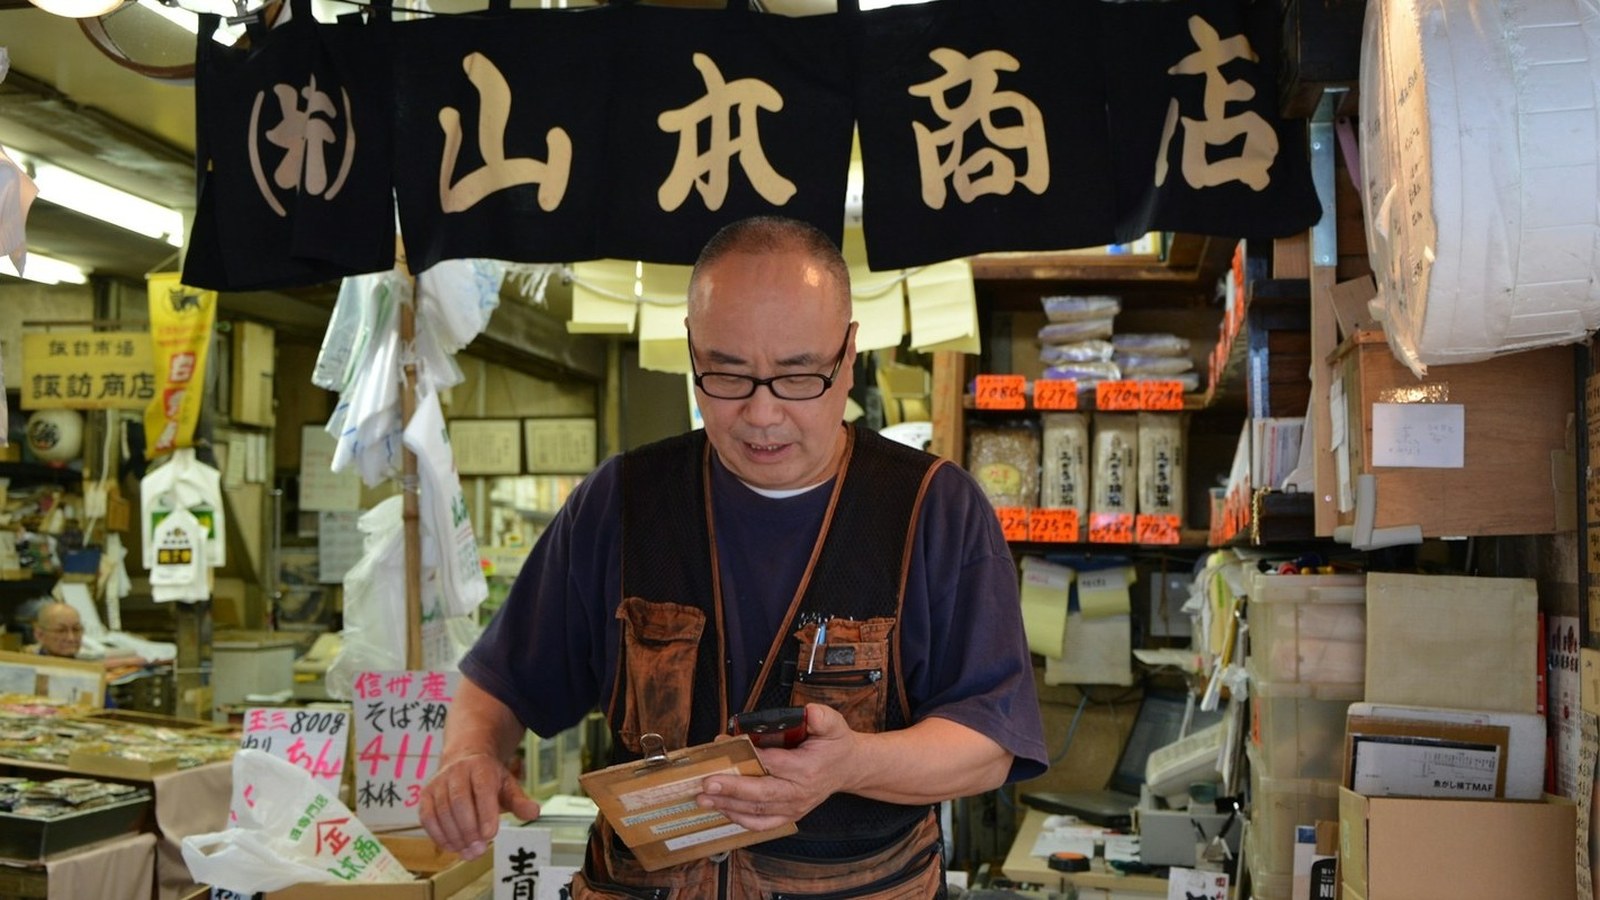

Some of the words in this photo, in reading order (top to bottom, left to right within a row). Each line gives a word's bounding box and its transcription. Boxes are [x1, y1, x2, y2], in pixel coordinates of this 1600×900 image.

[32, 373, 156, 400] 諏訪商店
[290, 711, 346, 735] 800g
